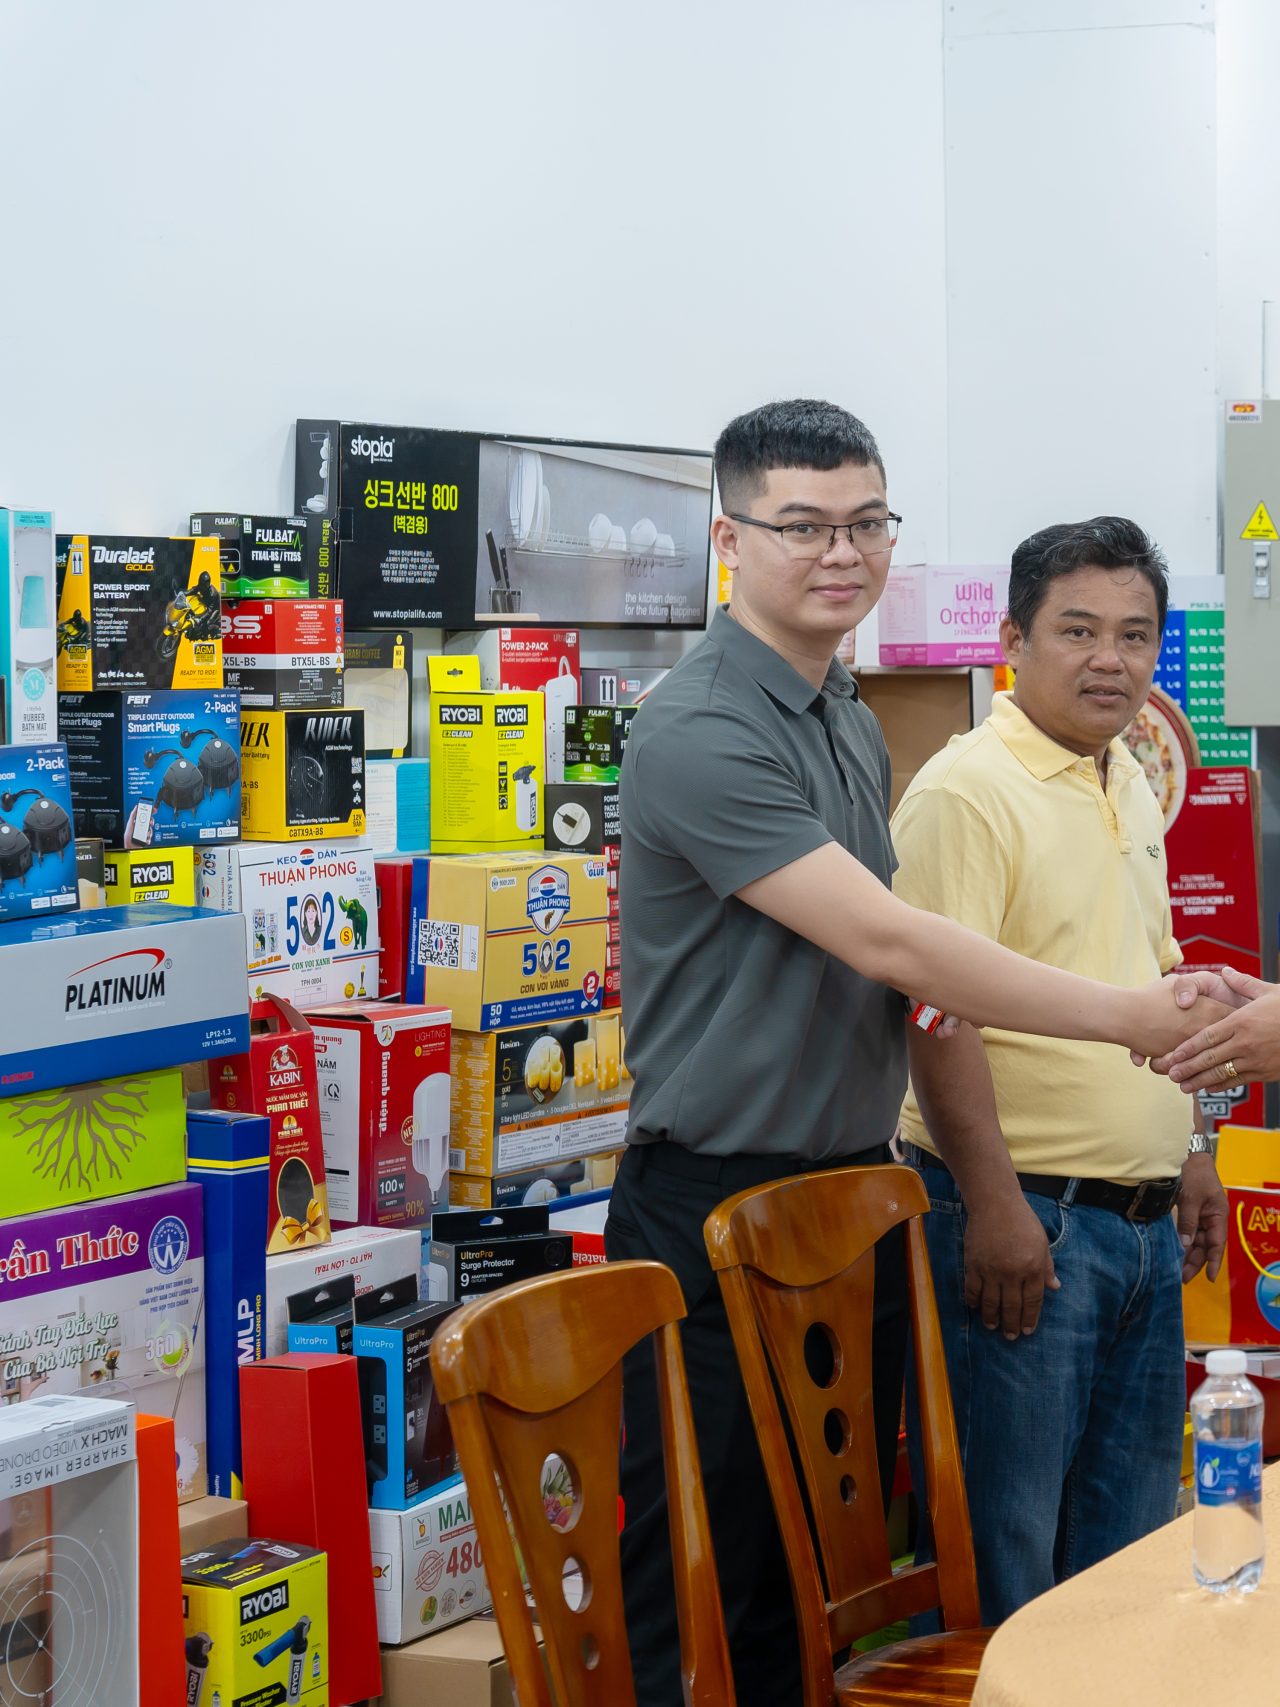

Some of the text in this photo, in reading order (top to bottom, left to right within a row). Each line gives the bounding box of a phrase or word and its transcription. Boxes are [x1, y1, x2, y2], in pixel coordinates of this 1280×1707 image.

[350, 434, 394, 464] stopia
[432, 484, 458, 512] 800
[255, 528, 294, 543] FULBAT
[91, 545, 155, 564] Duralast
[638, 592, 664, 604] kitchen
[955, 583, 993, 602] Wild
[373, 609, 443, 621] www.stopialife.com
[195, 643, 215, 655] AGM
[501, 642, 548, 651] POWER 2-PACK
[956, 648, 996, 659] pink guava
[291, 656, 330, 666] BTX5L-BS
[59, 695, 84, 703] FEIT
[127, 695, 151, 705] FEIT
[204, 701, 237, 714] 2-Pack
[23, 713, 45, 723] RUBBER
[440, 706, 481, 723] RYOBI
[497, 708, 527, 723] RYOBI
[21, 722, 47, 732] BATH MAT
[82, 718, 102, 727] Plugs
[127, 722, 181, 733] Smart Plugs
[26, 757, 65, 772] 2-Pack
[277, 856, 298, 865] KEO
[132, 864, 173, 884] RYOBI
[310, 861, 357, 880] PHONG
[588, 868, 605, 877] GLUE
[549, 898, 570, 908] PHONG
[343, 931, 351, 942] S
[292, 961, 304, 971] CON
[305, 960, 315, 969] VOI
[316, 957, 331, 968] XANH
[301, 979, 311, 987] TPH
[520, 978, 569, 994] CON VOI VÀNG
[587, 978, 596, 993] 2
[64, 971, 165, 1012] PLATINUM
[490, 1004, 502, 1015] 50
[490, 1017, 501, 1026] HỘP
[205, 1028, 232, 1040] LP12-1.3
[414, 1029, 447, 1042] LIGHTING
[500, 1040, 520, 1050] fusion
[502, 1058, 511, 1082] 5
[270, 1071, 301, 1086] KABIN
[266, 1102, 289, 1113] PHAN
[379, 1178, 397, 1194] 100
[405, 1200, 425, 1216] 90%
[56, 1225, 139, 1270] Thức
[460, 1250, 494, 1260] UltraPro
[460, 1259, 515, 1270] Surge Protector
[460, 1274, 469, 1287] 9
[33, 1324, 62, 1347] Tay
[237, 1298, 255, 1366] MLP
[145, 1333, 174, 1361] 360
[294, 1336, 328, 1346] UltraPro
[360, 1338, 394, 1349] UltraPro
[91, 1423, 127, 1446] MACH
[43, 1439, 78, 1459] VIDEO
[14, 1444, 127, 1488] SHARPER IMAGE
[242, 1585, 288, 1620] RYOBI
[291, 1661, 301, 1695] RYOBI
[187, 1672, 200, 1704] RYOBI
